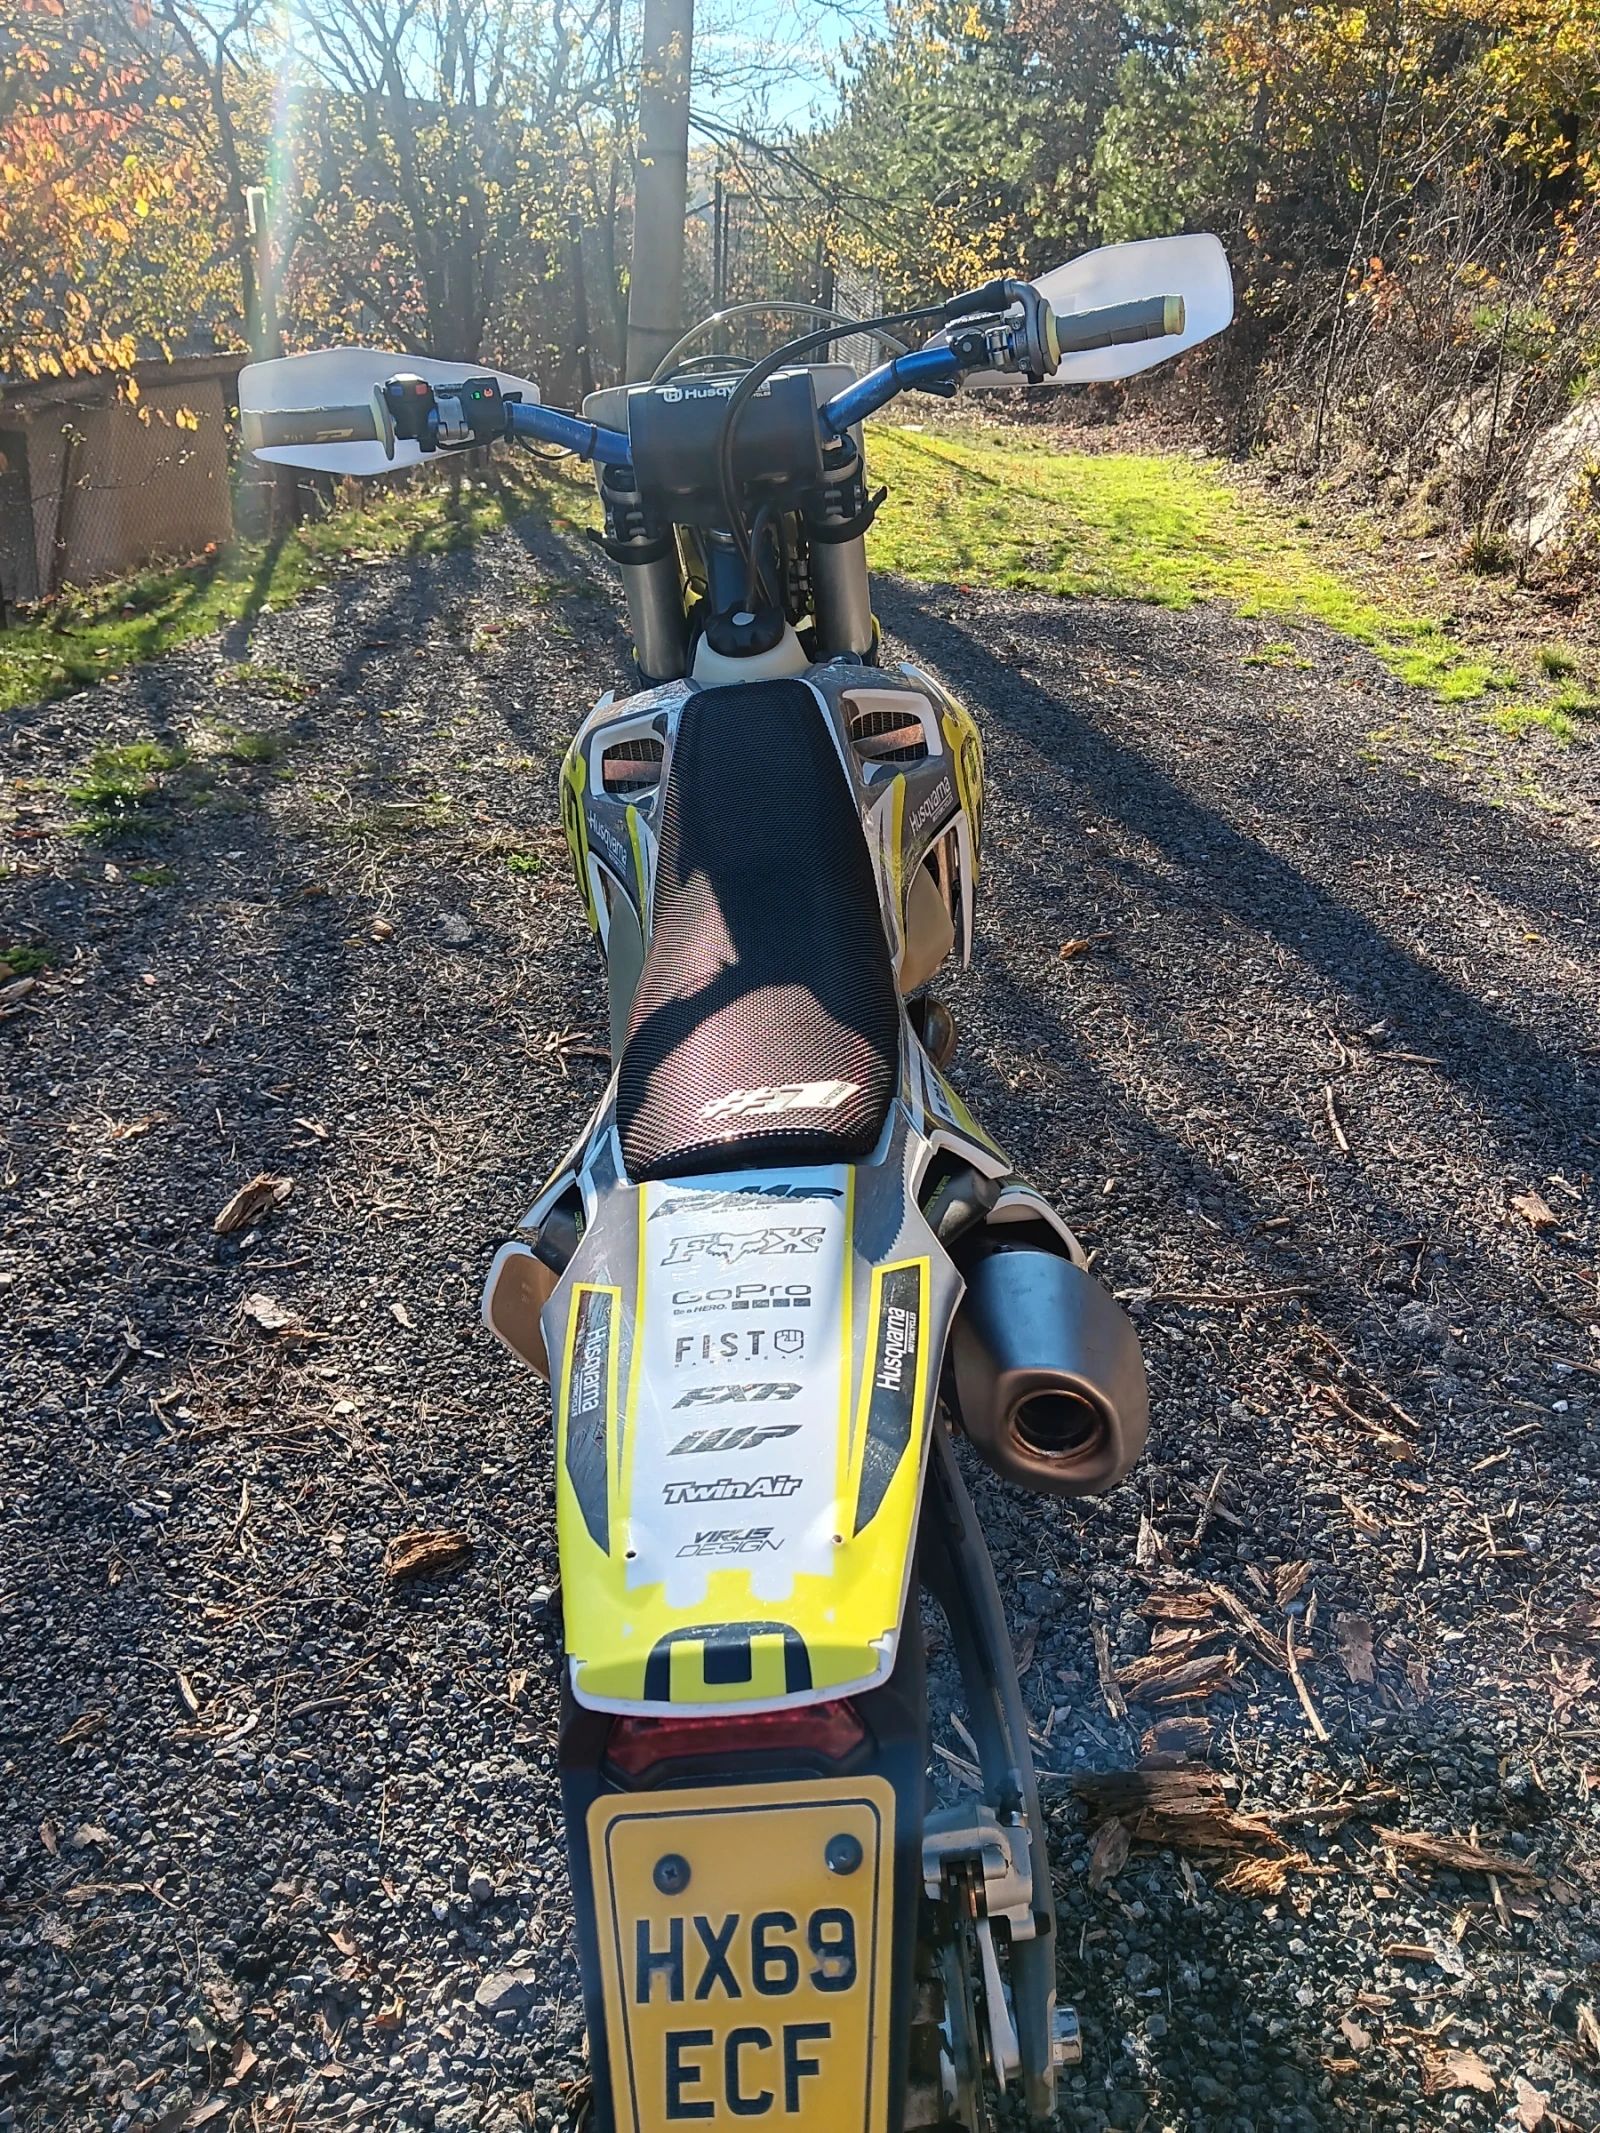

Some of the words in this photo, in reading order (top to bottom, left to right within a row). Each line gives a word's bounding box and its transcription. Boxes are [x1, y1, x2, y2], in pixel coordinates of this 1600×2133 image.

[910, 776, 951, 836] Husqvarna
[587, 810, 627, 865] Husqvarna
[672, 1284, 812, 1305] GoPro
[675, 1330, 765, 1362] FIST
[876, 1307, 907, 1391] Husqvarna
[908, 1312, 917, 1353] MOTORCYCLES
[582, 1325, 607, 1413] Husqvarna
[671, 1382, 803, 1409] FXR
[666, 1424, 803, 1456] WP
[675, 1538, 786, 1558] DESIGN
[694, 1526, 775, 1543] VIRUS
[635, 1908, 858, 2004] HX69
[665, 2022, 832, 2120] ECF
